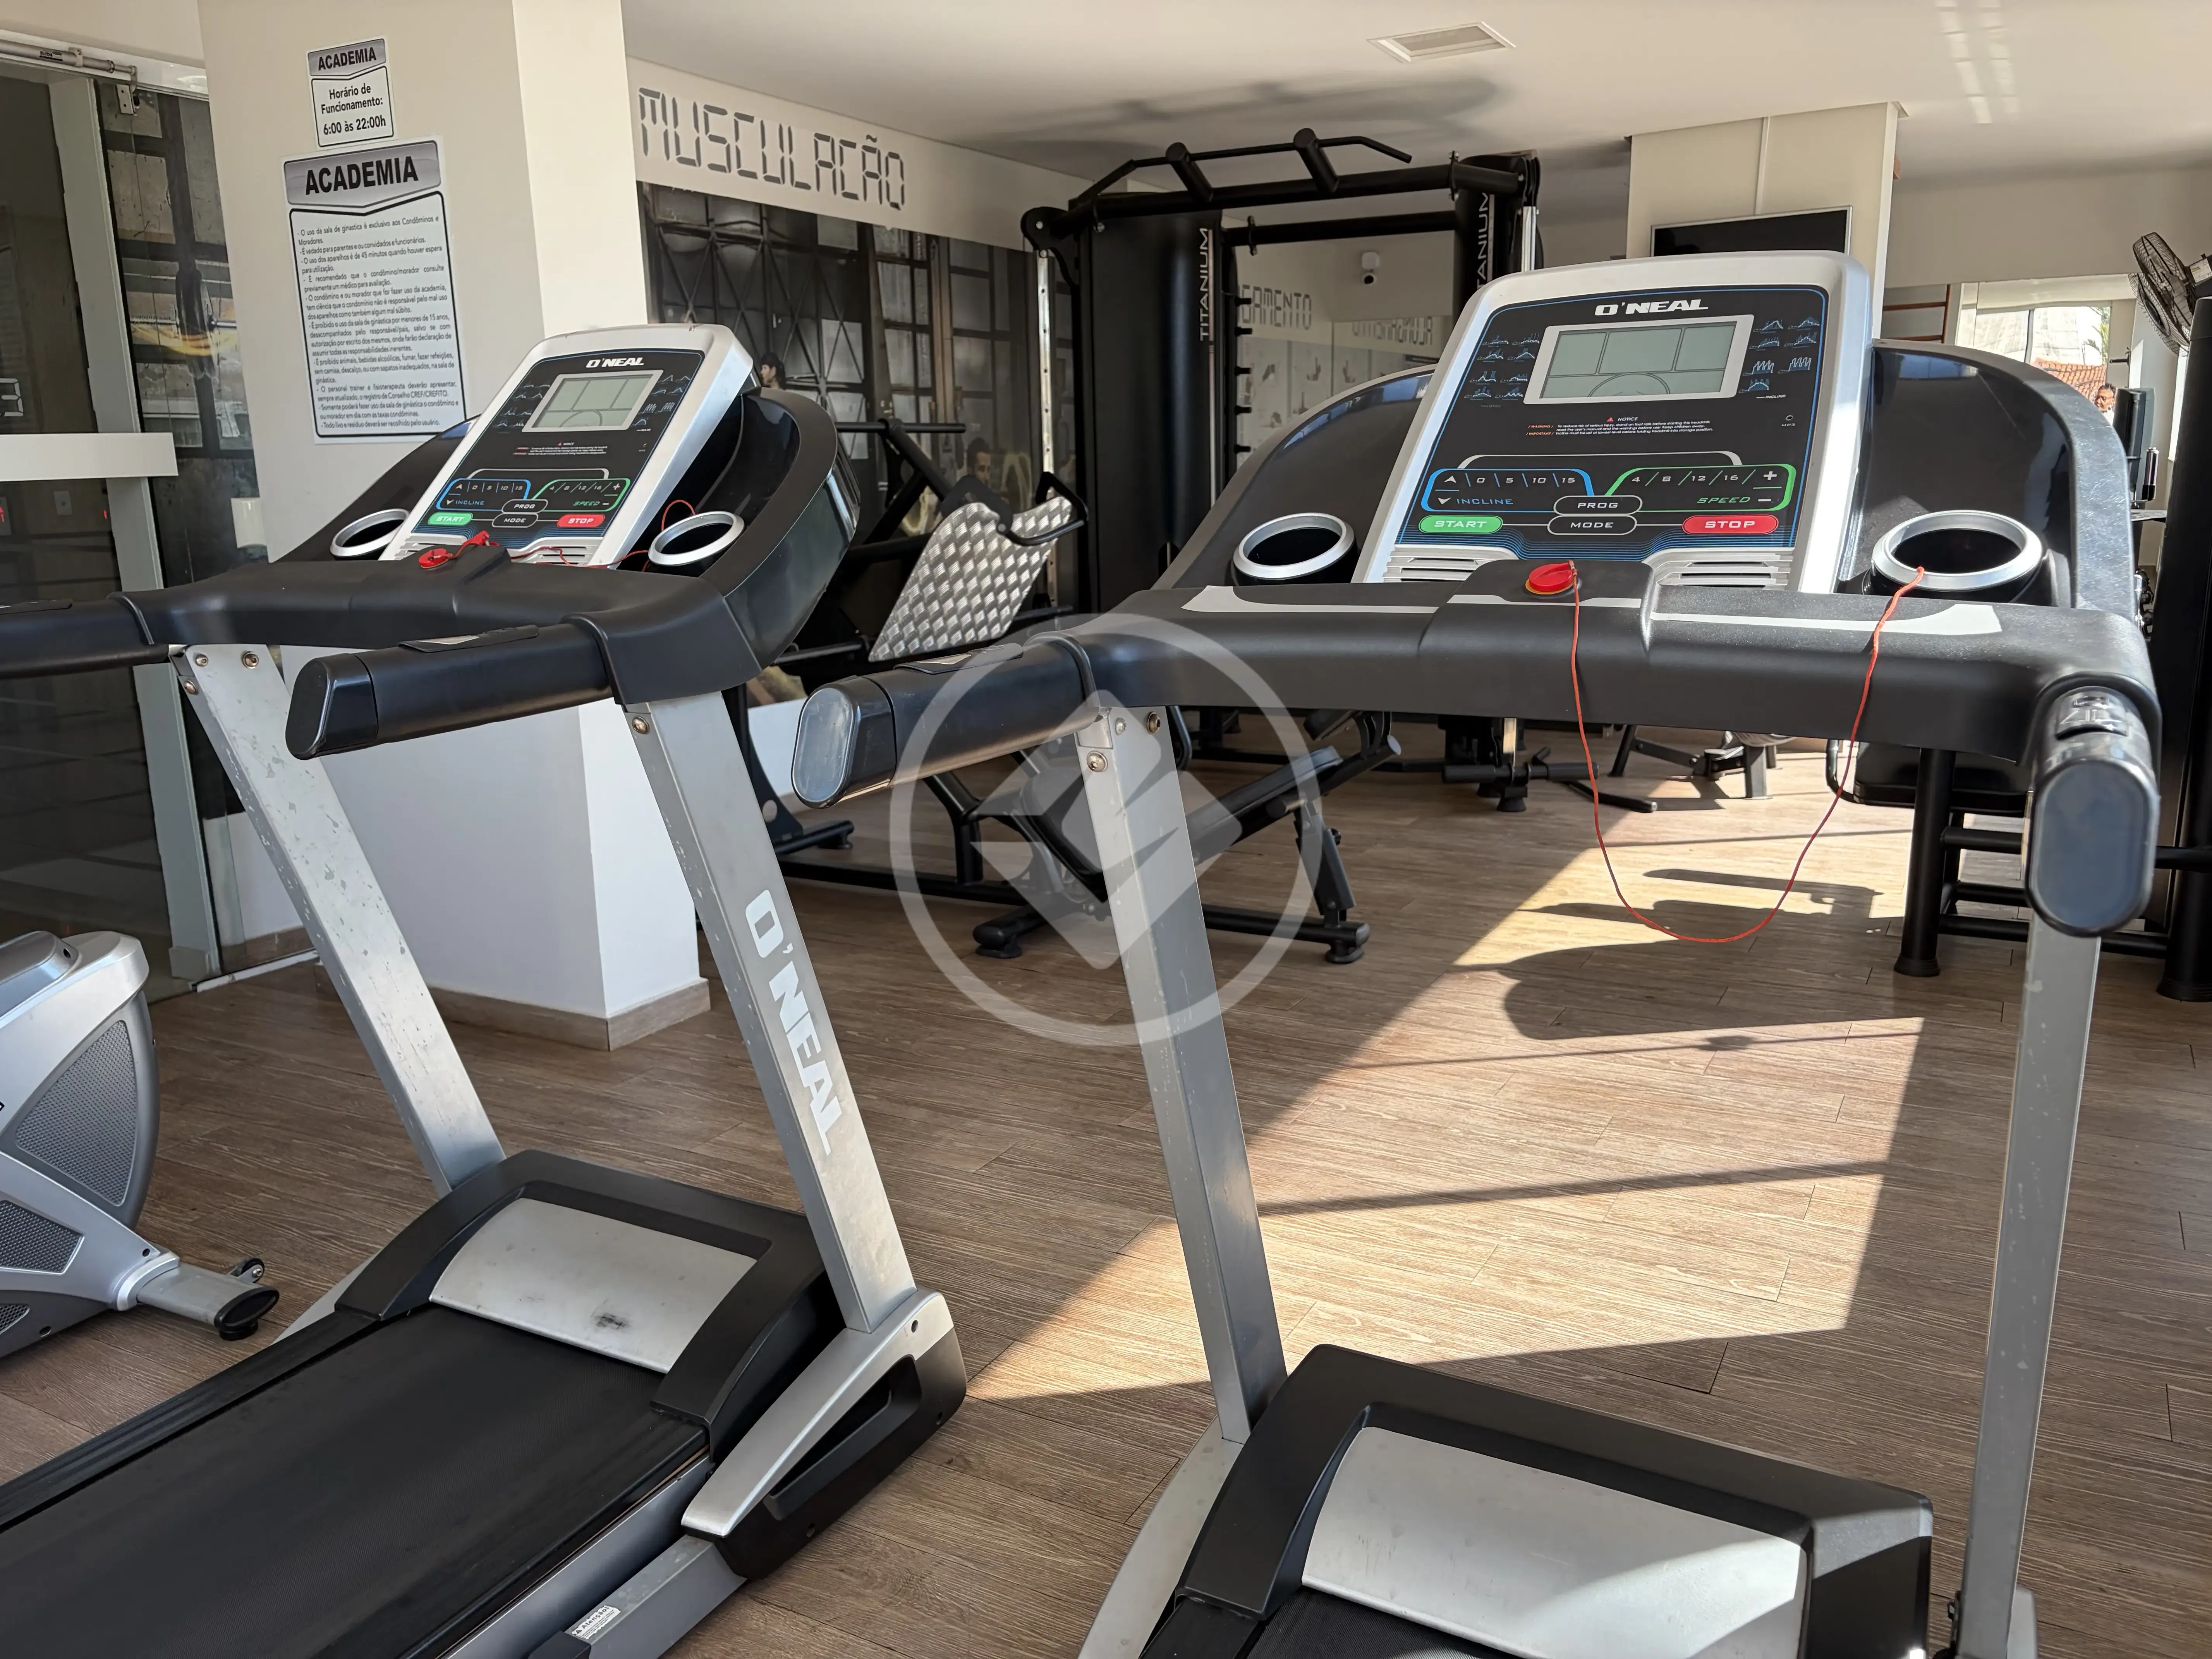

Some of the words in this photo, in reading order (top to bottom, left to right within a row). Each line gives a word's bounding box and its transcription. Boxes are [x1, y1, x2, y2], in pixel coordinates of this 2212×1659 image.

[318, 47, 376, 71] ACADEMIA
[329, 86, 359, 100] Horário
[361, 83, 371, 94] de
[321, 96, 383, 114] Funcionamento:
[323, 122, 342, 135] 6:00
[344, 121, 354, 132] às
[356, 115, 386, 130] 22:00h
[306, 156, 419, 195] ACADEMIA
[1477, 192, 1488, 289] TANIUM
[423, 264, 444, 273] consulte
[1199, 228, 1209, 341] TITANIUM
[1242, 284, 1311, 330] GAMENTO
[1595, 299, 1709, 316] O'NEAL
[586, 357, 644, 368] O'NEAL
[745, 890, 843, 1156] O'NEAL
